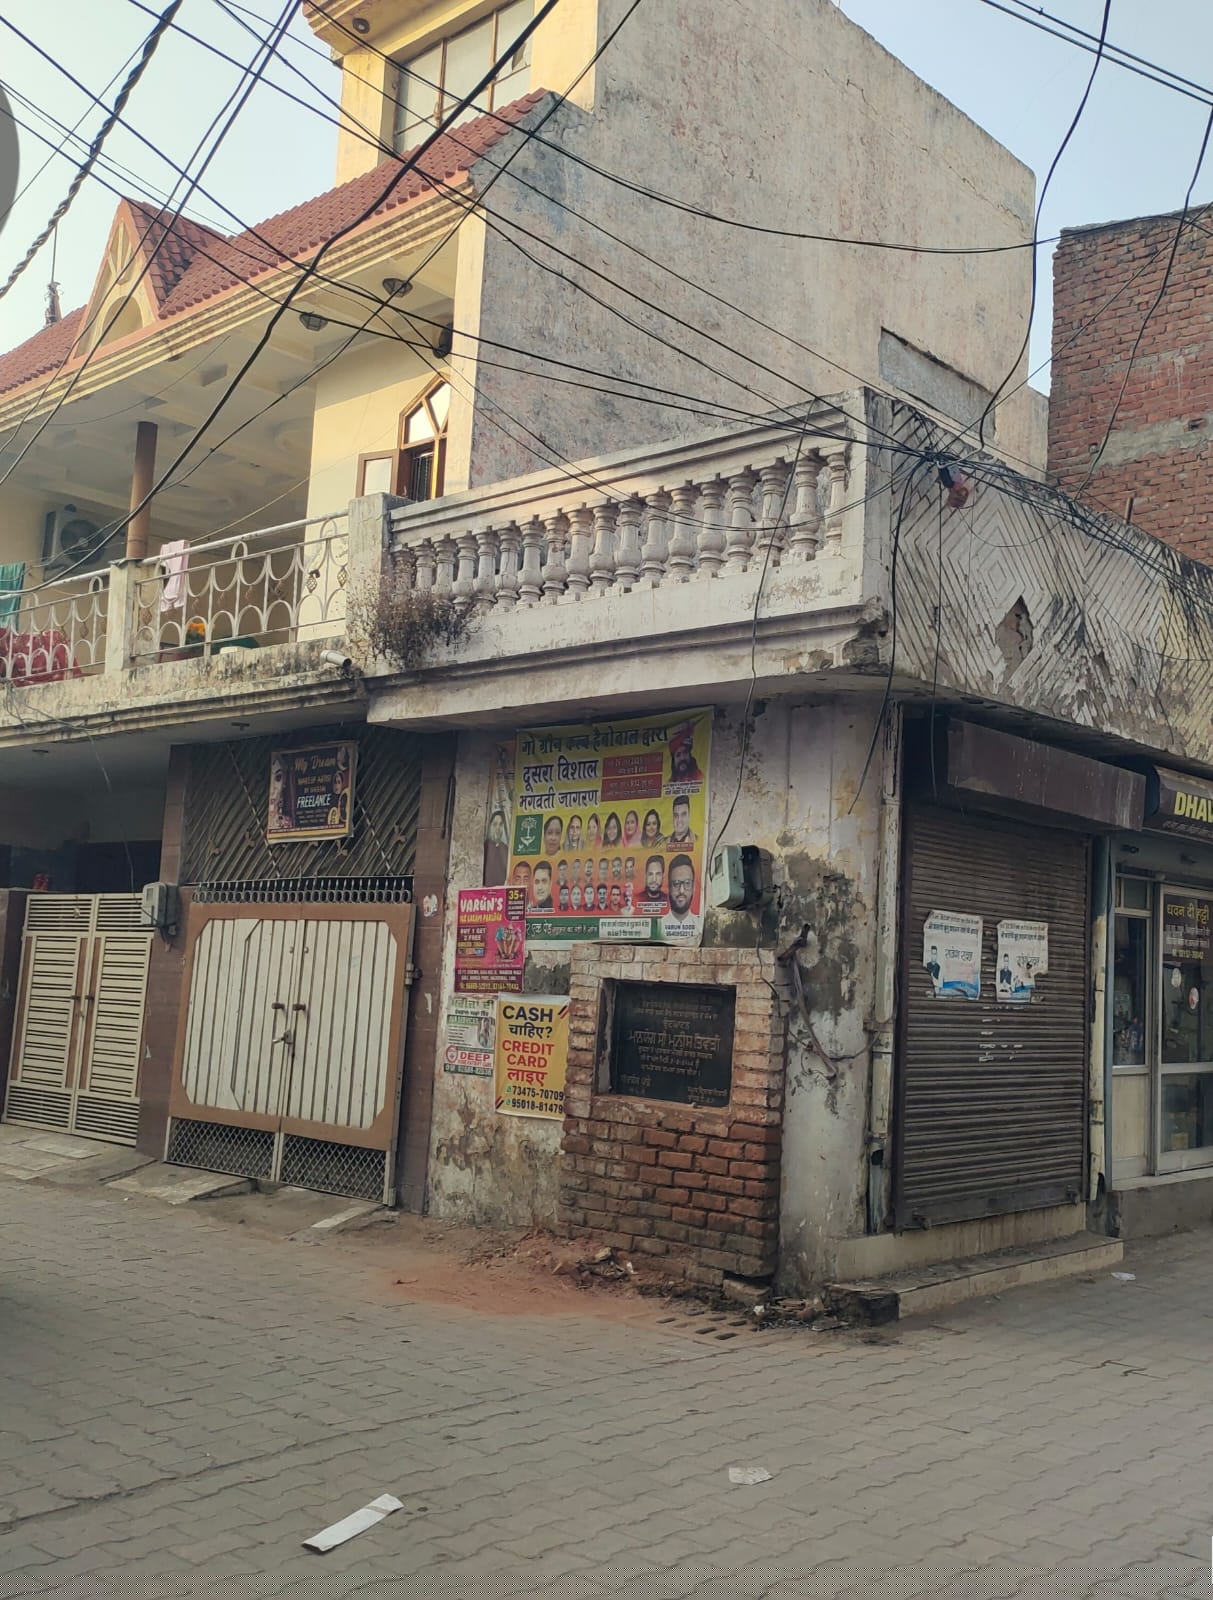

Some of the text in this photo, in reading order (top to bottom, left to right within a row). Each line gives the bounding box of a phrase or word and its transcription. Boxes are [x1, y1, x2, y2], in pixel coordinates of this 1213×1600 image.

[523, 765, 554, 793] दूसरा
[557, 755, 599, 781] विशाल
[296, 793, 332, 808] FREELANCE
[558, 789, 600, 807] जागरण
[1174, 791, 1213, 823] DHA
[508, 890, 524, 900] 35+
[502, 1005, 553, 1023] CASH
[508, 1022, 553, 1039] चाहिए?
[502, 1040, 555, 1056] CREDIT
[460, 1051, 490, 1062] DEEP
[506, 1054, 548, 1068] CARD
[506, 1068, 549, 1087] लाइए
[512, 1085, 564, 1101] 73475-70709
[511, 1098, 564, 1114] 95018-81479
